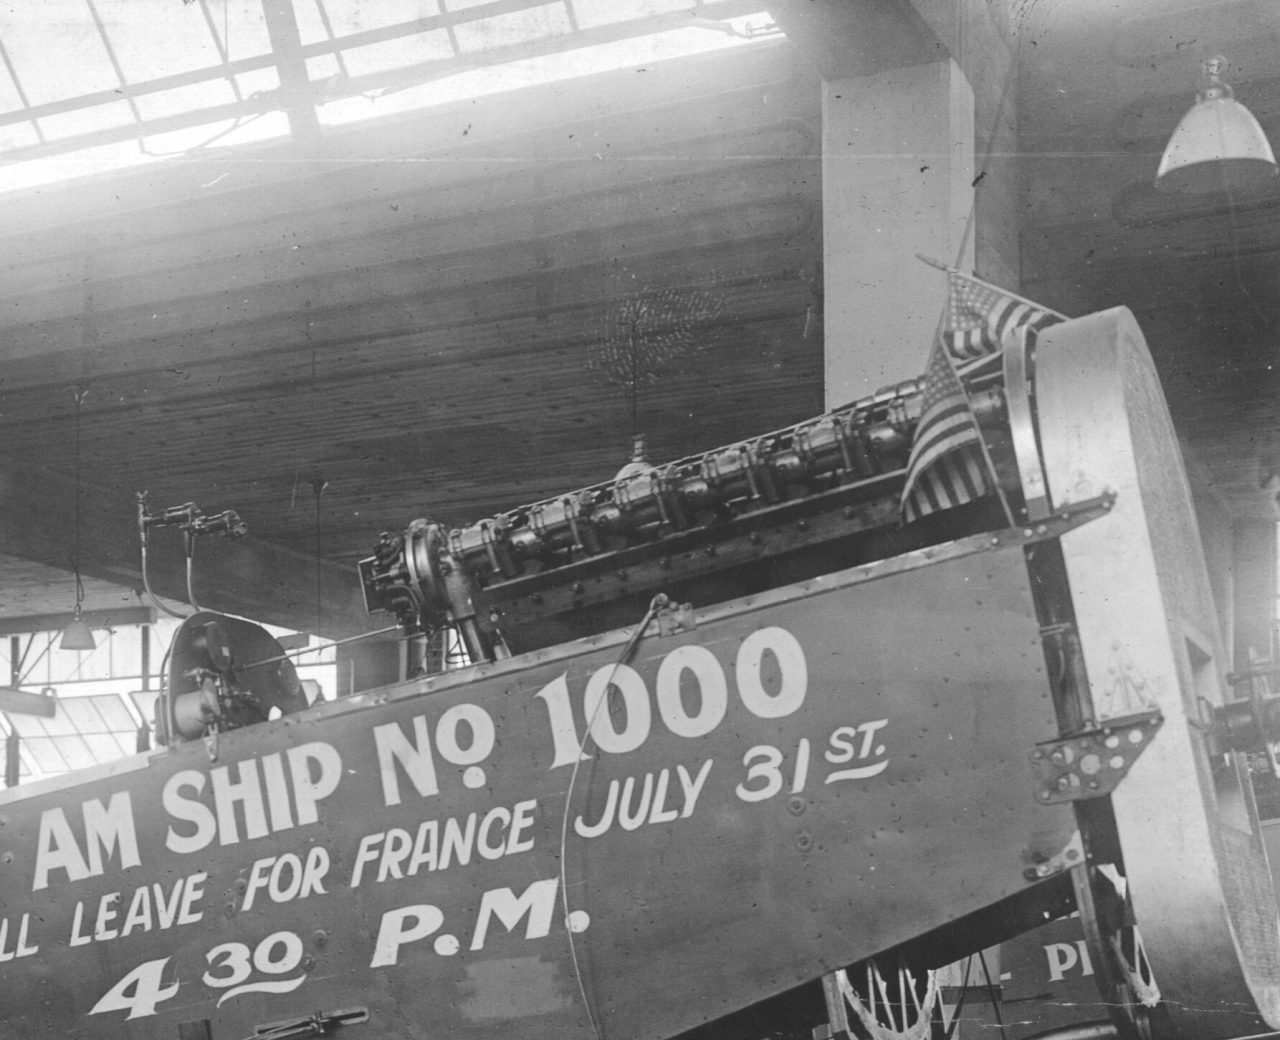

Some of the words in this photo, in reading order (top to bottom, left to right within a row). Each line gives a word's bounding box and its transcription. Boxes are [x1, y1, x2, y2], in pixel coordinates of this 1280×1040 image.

[32, 790, 142, 890] AM
[163, 742, 342, 855] SHIP
[535, 626, 809, 770] 1000
[70, 873, 206, 948] LEAVE
[242, 845, 330, 912] FOR
[350, 800, 538, 889] FRANCE
[574, 759, 713, 840] JULY
[370, 876, 591, 968] P.M.
